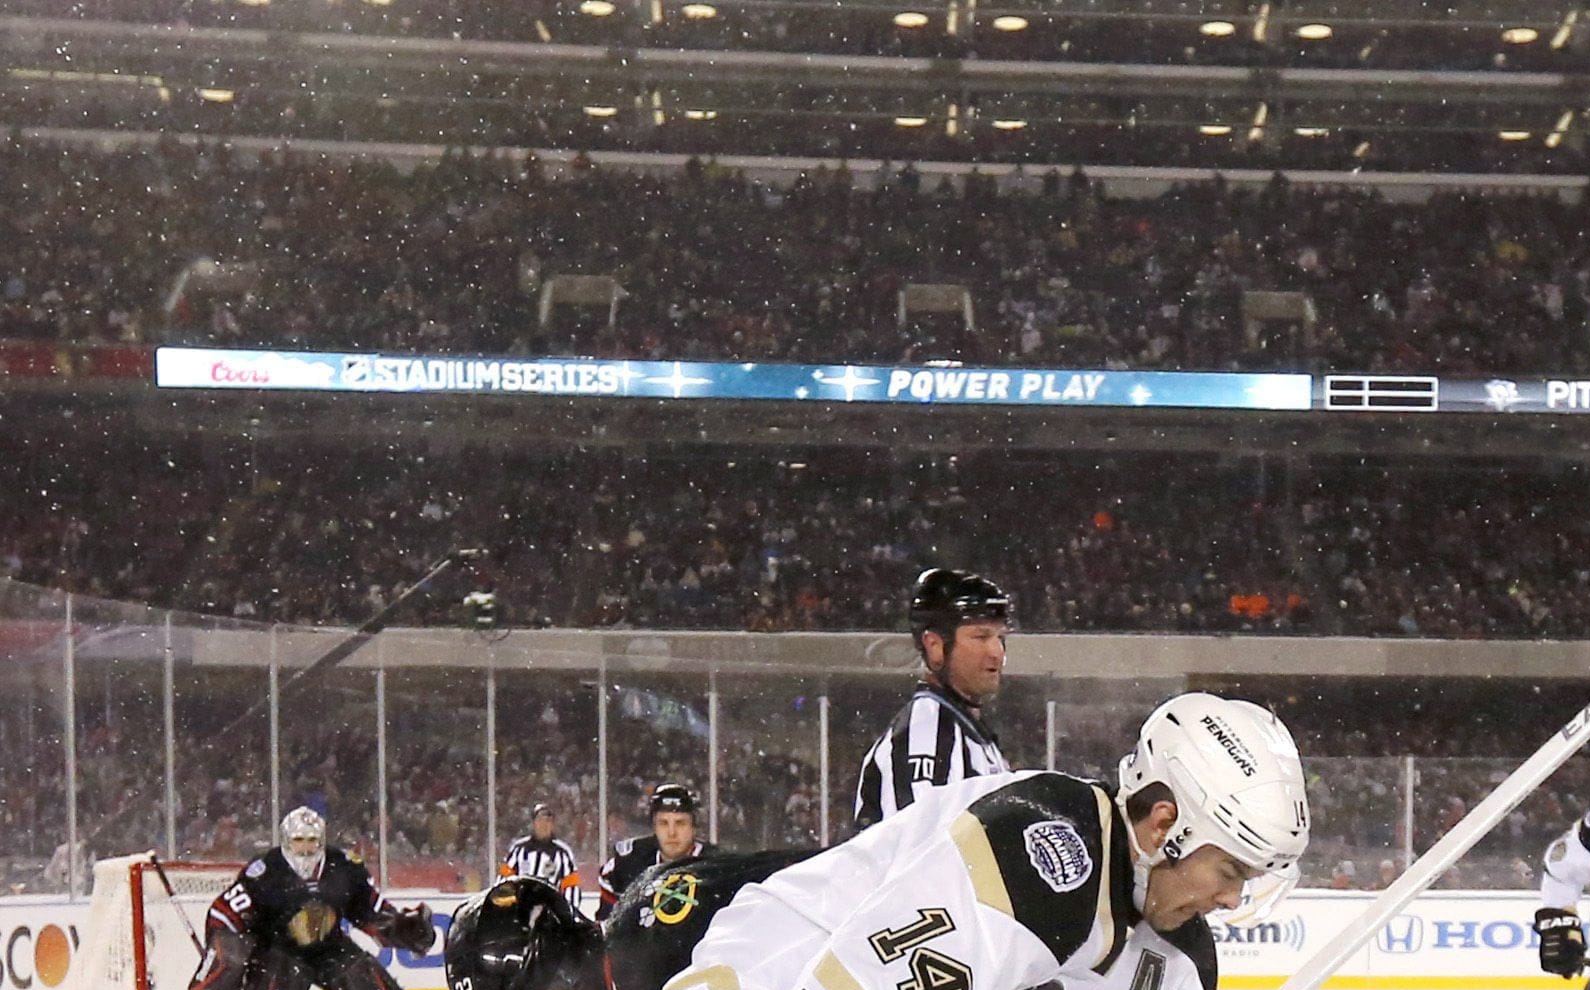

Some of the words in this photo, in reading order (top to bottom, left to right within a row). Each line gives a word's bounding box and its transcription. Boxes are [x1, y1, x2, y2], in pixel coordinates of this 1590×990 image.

[887, 370, 1011, 399] POWER
[1020, 373, 1105, 401] PLAY
[1200, 715, 1257, 778] PENGUINS
[907, 757, 936, 780] 70
[223, 883, 252, 913] 50
